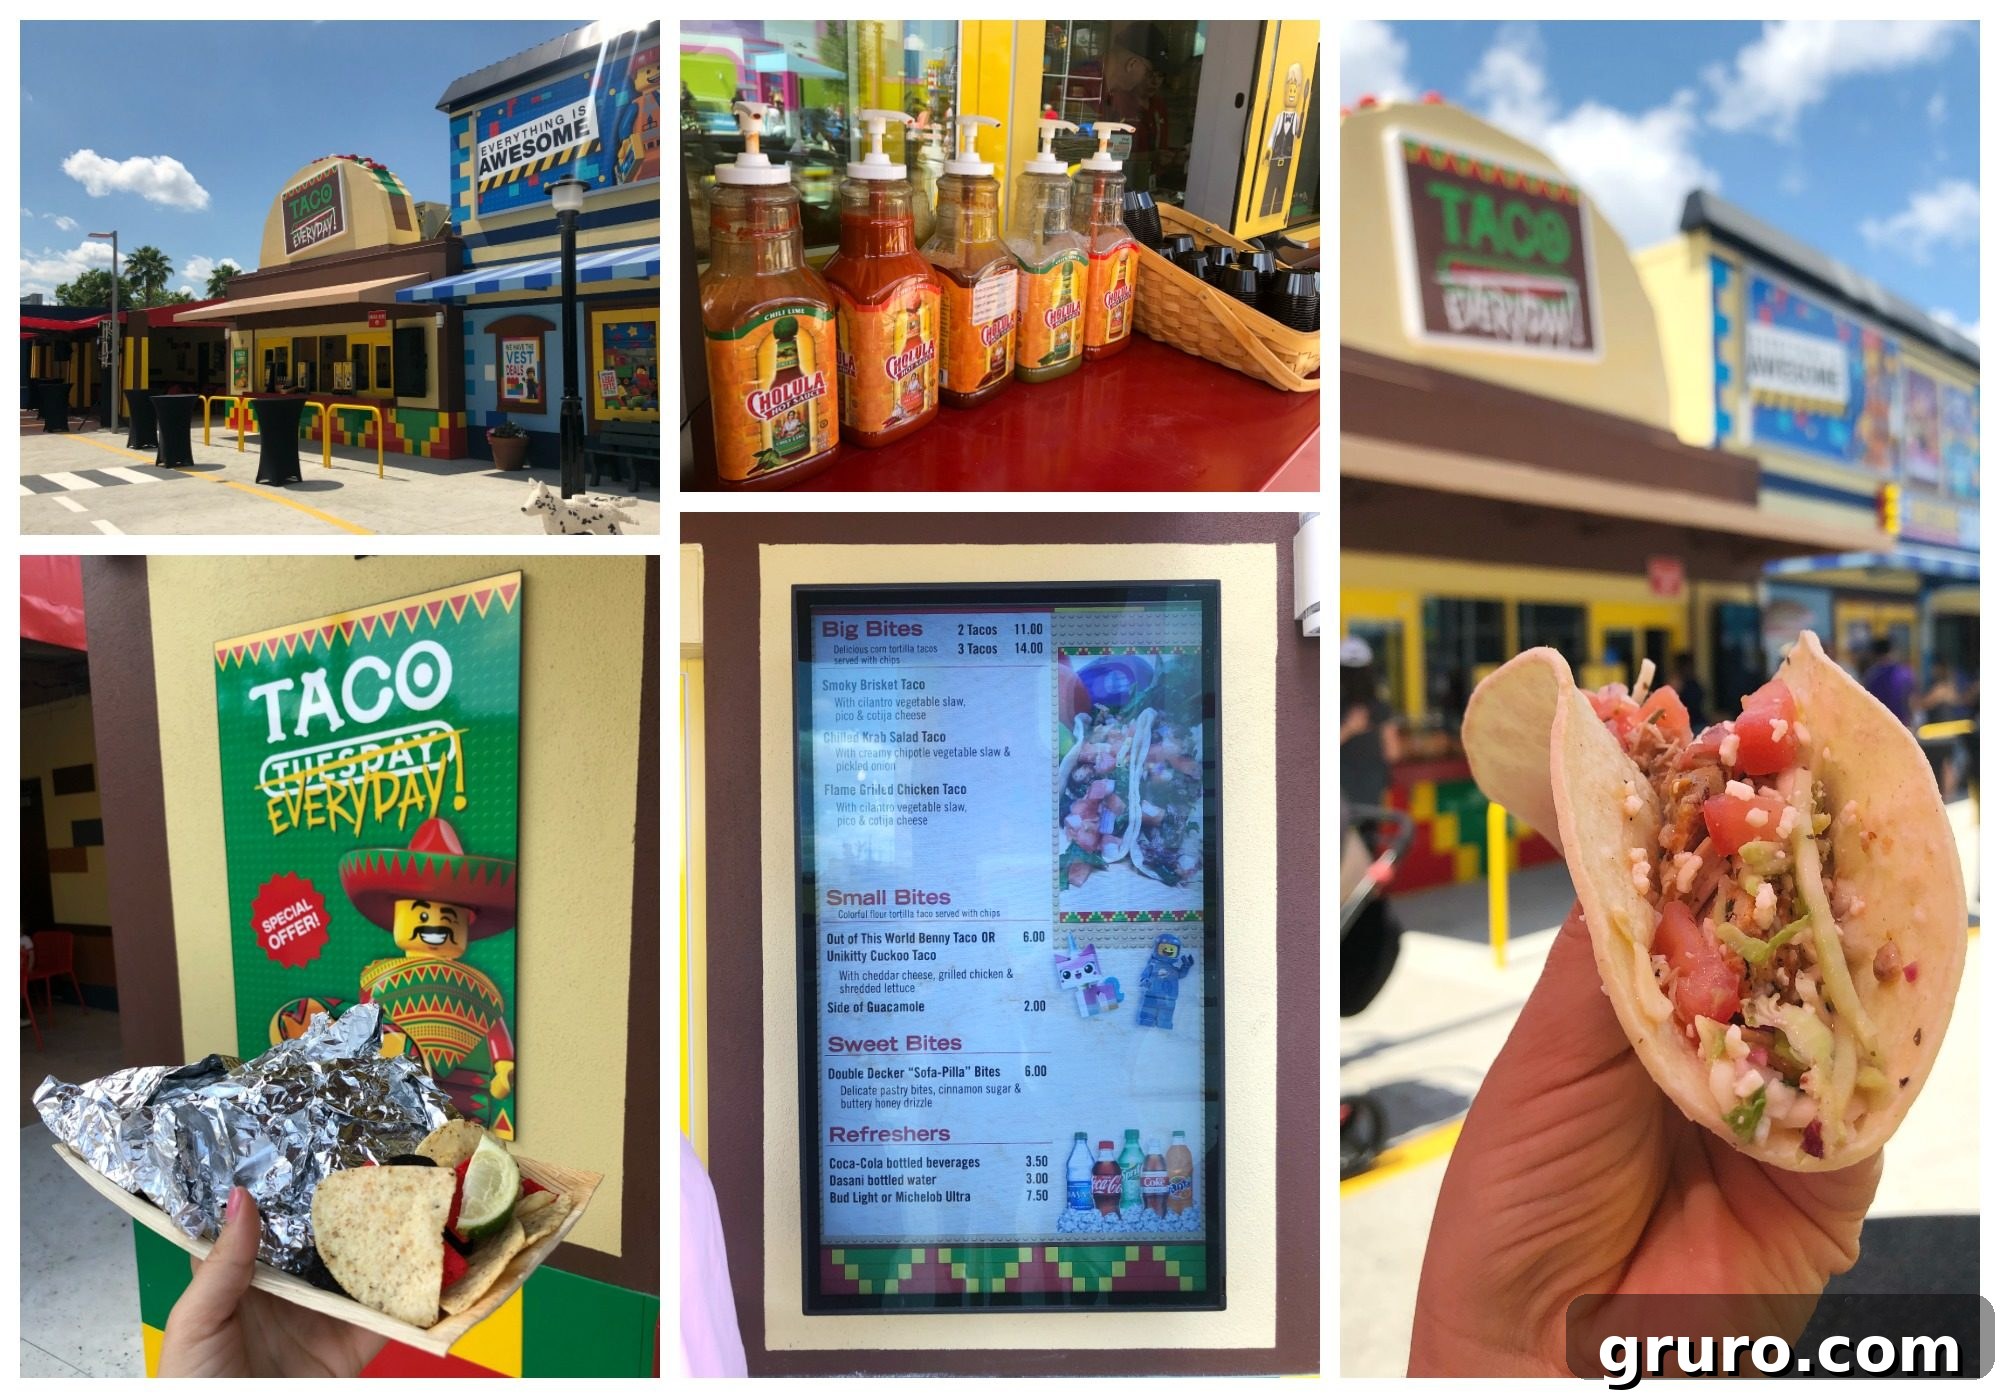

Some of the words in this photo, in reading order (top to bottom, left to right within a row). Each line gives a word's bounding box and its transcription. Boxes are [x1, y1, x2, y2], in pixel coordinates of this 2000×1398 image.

[481, 114, 565, 157] EVERYTHING
[572, 105, 586, 118] IS
[479, 118, 590, 176] AWESOME
[289, 183, 333, 219] TACO
[1427, 180, 1572, 265] TACO
[764, 309, 786, 321] CHILI
[788, 307, 805, 315] LIME
[1045, 301, 1081, 329] CHOLULA
[506, 351, 534, 364] VEST
[885, 339, 935, 380] CHOLULA
[505, 364, 524, 376] DEALS
[747, 371, 826, 419] CHOLULA
[771, 401, 791, 416] HOT
[792, 389, 821, 405] SAUCE
[822, 620, 858, 640] Big
[866, 620, 923, 637] Bites
[958, 624, 964, 635] 2
[968, 624, 997, 635] Tacos
[1015, 623, 1043, 635] 11.00
[834, 645, 868, 654] Delicious
[889, 645, 915, 653] tortilla
[917, 645, 938, 653] tacos
[958, 643, 964, 654] 3
[968, 643, 997, 654] Tacos
[1015, 642, 1043, 654] 14.00
[834, 656, 858, 665] served
[861, 656, 877, 664] with
[880, 655, 900, 666] chips
[248, 640, 453, 743] TACO
[823, 680, 857, 693] Smoky
[861, 679, 898, 690] Brisket
[902, 679, 925, 690] Taco
[835, 698, 855, 707] With
[858, 697, 892, 707] cilantro
[896, 697, 940, 709] vegetable
[943, 696, 966, 707] slaw,
[835, 711, 854, 723] pico
[858, 711, 864, 721] &
[867, 711, 892, 722] cotija
[895, 710, 926, 720] cheese
[824, 732, 859, 743] Chilled
[863, 731, 886, 743] Krab
[890, 731, 918, 743] Salad
[922, 731, 946, 742] Taco
[271, 730, 440, 790] TUESDAY
[836, 748, 855, 758] With
[859, 749, 891, 760] creamy
[895, 747, 930, 760] chipotle
[933, 747, 977, 759] vegetable
[980, 747, 1000, 757] slaw
[1004, 747, 1010, 756] &
[837, 761, 868, 772] pickled
[872, 762, 895, 771] onion
[266, 730, 468, 838] EVERYDAY!
[825, 784, 855, 795] Flame
[860, 784, 893, 795] Grilled
[897, 783, 939, 795] Chicken
[943, 783, 967, 795] Taco
[837, 802, 856, 812] With
[860, 802, 894, 812] cilantro
[897, 802, 941, 813] vegetable
[944, 802, 967, 813] slaw,
[838, 816, 855, 827] pico
[859, 816, 866, 825] &
[869, 816, 893, 827] cotija
[897, 816, 928, 825] cheese
[827, 889, 886, 905] Small
[895, 889, 951, 905] Bites
[261, 898, 314, 934] SPECIAL
[838, 910, 868, 919] Colorful
[870, 909, 887, 918] flour
[889, 909, 915, 918] tortilla
[917, 910, 933, 918] taco
[935, 909, 959, 918] served
[962, 909, 978, 917] with
[980, 909, 1000, 919] chips
[268, 911, 322, 950] OFFER!
[827, 934, 844, 944] Out
[849, 933, 858, 944] of
[861, 933, 882, 944] This
[885, 933, 915, 944] World
[919, 933, 950, 945] Benny
[954, 932, 977, 943] Taco
[982, 932, 995, 943] OR
[1023, 931, 1045, 942] 6.00
[827, 951, 866, 963] Unikitty
[871, 950, 909, 961] Cuckoo
[913, 950, 936, 961] Taco
[840, 970, 859, 980] With
[863, 970, 899, 980] cheddar
[902, 970, 935, 981] cheese,
[939, 969, 967, 981] grilled
[970, 969, 1003, 979] chicken
[1007, 969, 1013, 978] &
[840, 984, 881, 994] shredded
[884, 983, 915, 993] lettuce
[828, 1002, 850, 1013] Side
[854, 1002, 863, 1013] of
[867, 1001, 924, 1013] Guacamole
[1024, 1001, 1046, 1012] 2.00
[828, 1036, 898, 1052] Sweet
[907, 1035, 962, 1051] Bites
[828, 1068, 863, 1079] Double
[868, 1068, 904, 1079] Decker
[975, 1066, 1000, 1077] Bites
[1025, 1065, 1047, 1076] 6.00
[841, 1085, 877, 1096] Delicate
[880, 1085, 908, 1097] pastry
[911, 1085, 935, 1095] bites,
[939, 1084, 982, 1094] cinnamon
[986, 1084, 1011, 1095] sugar
[1015, 1084, 1021, 1093] &
[841, 1098, 872, 1110] buttery
[875, 1098, 901, 1110] honey
[904, 1098, 932, 1108] drizzle
[829, 1127, 950, 1142] Refreshers
[830, 1158, 883, 1169] Coca-Cola
[887, 1157, 923, 1168] bottled
[926, 1156, 980, 1169] beverages
[1026, 1156, 1047, 1167] 3.50
[830, 1175, 864, 1186] Dasani
[867, 1174, 903, 1185] bottled
[907, 1175, 936, 1185] water
[1026, 1173, 1048, 1184] 3.00
[830, 1192, 849, 1203] Bud
[853, 1191, 878, 1204] Light
[881, 1194, 892, 1202] or
[896, 1191, 942, 1202] Michelob
[946, 1190, 970, 1202] Ultra
[1027, 1190, 1048, 1201] 7.50
